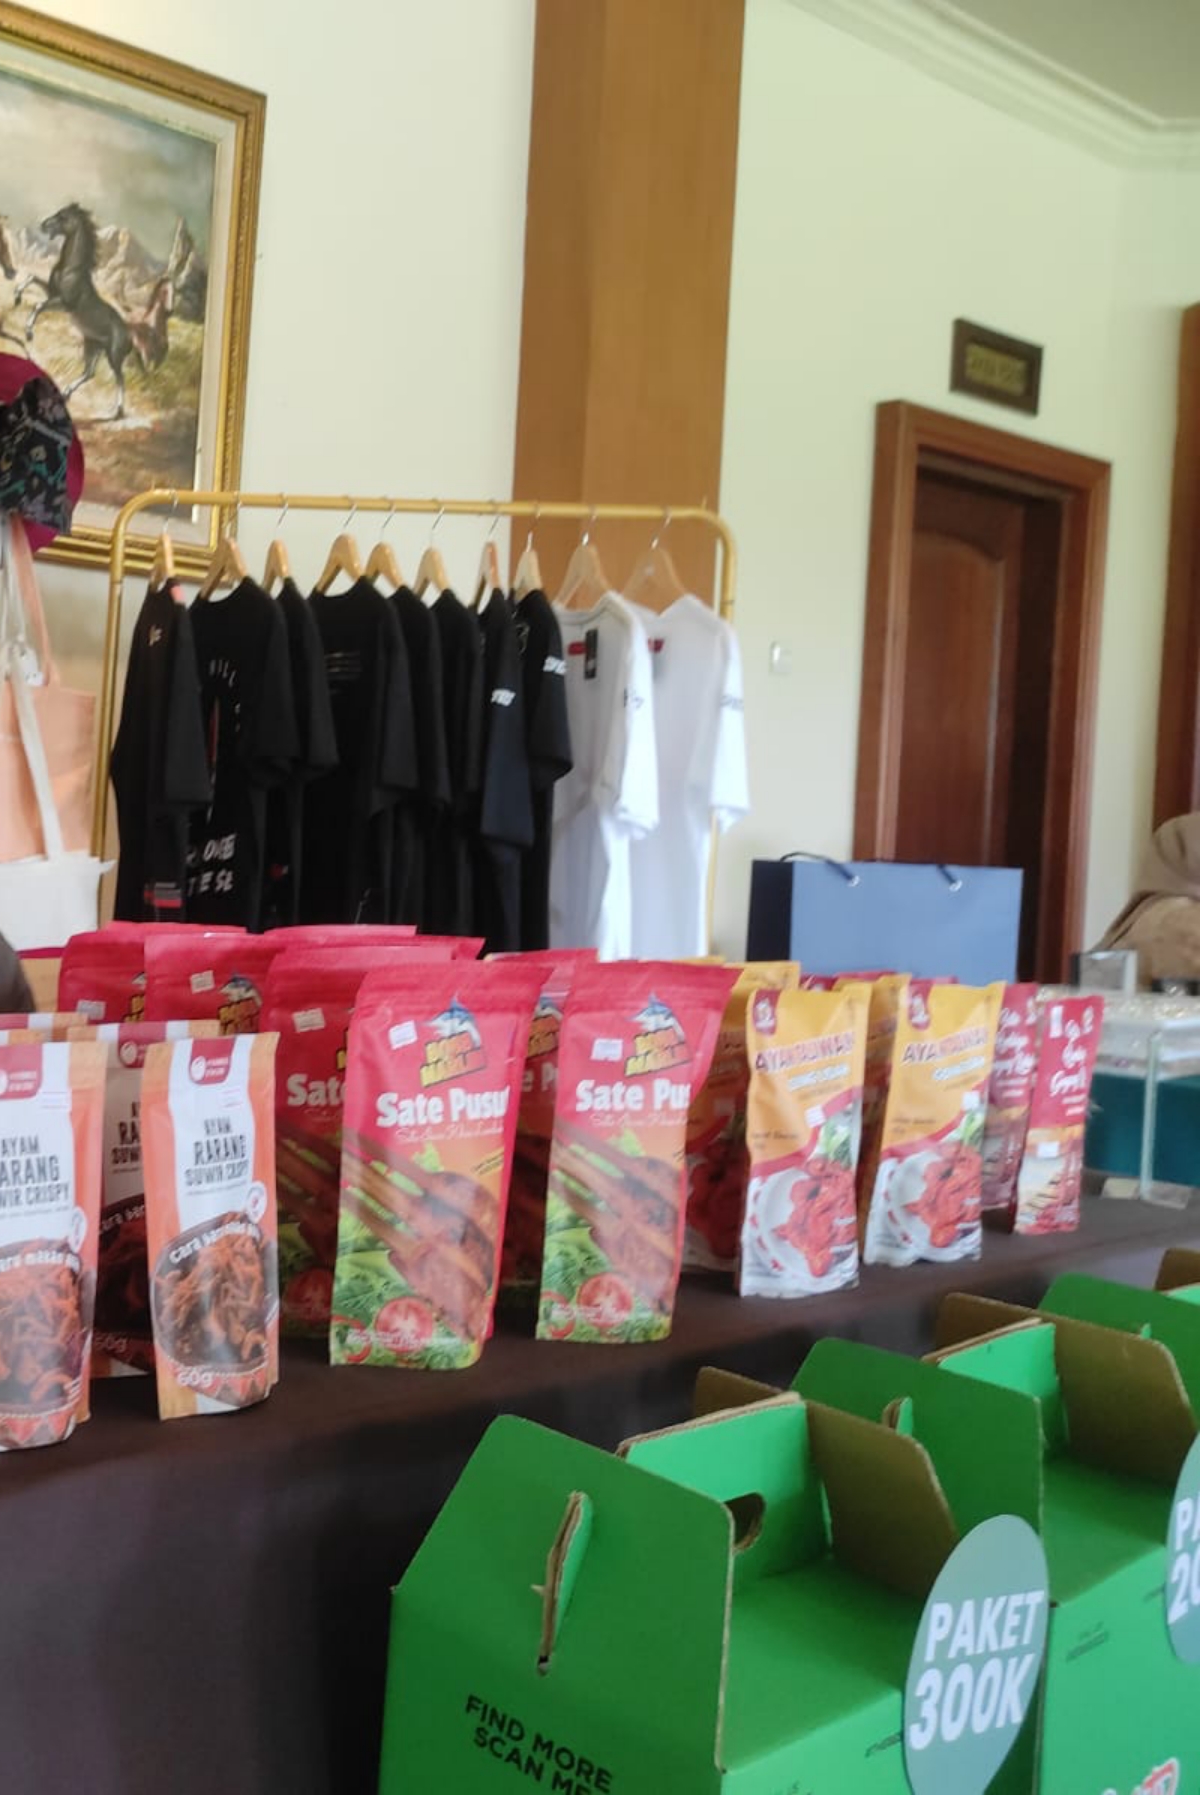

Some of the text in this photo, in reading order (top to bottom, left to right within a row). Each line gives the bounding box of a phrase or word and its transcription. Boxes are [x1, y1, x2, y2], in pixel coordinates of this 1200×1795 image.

[376, 1092, 443, 1128] Sate
[575, 1079, 645, 1113] Sate
[0, 1135, 39, 1158] AYAM
[25, 1181, 69, 1206] CRISPY
[924, 1590, 1045, 1663] PAKET
[909, 1653, 1035, 1750] 300K
[465, 1694, 613, 1794] FIND MORE
[473, 1727, 544, 1782] SCAN
